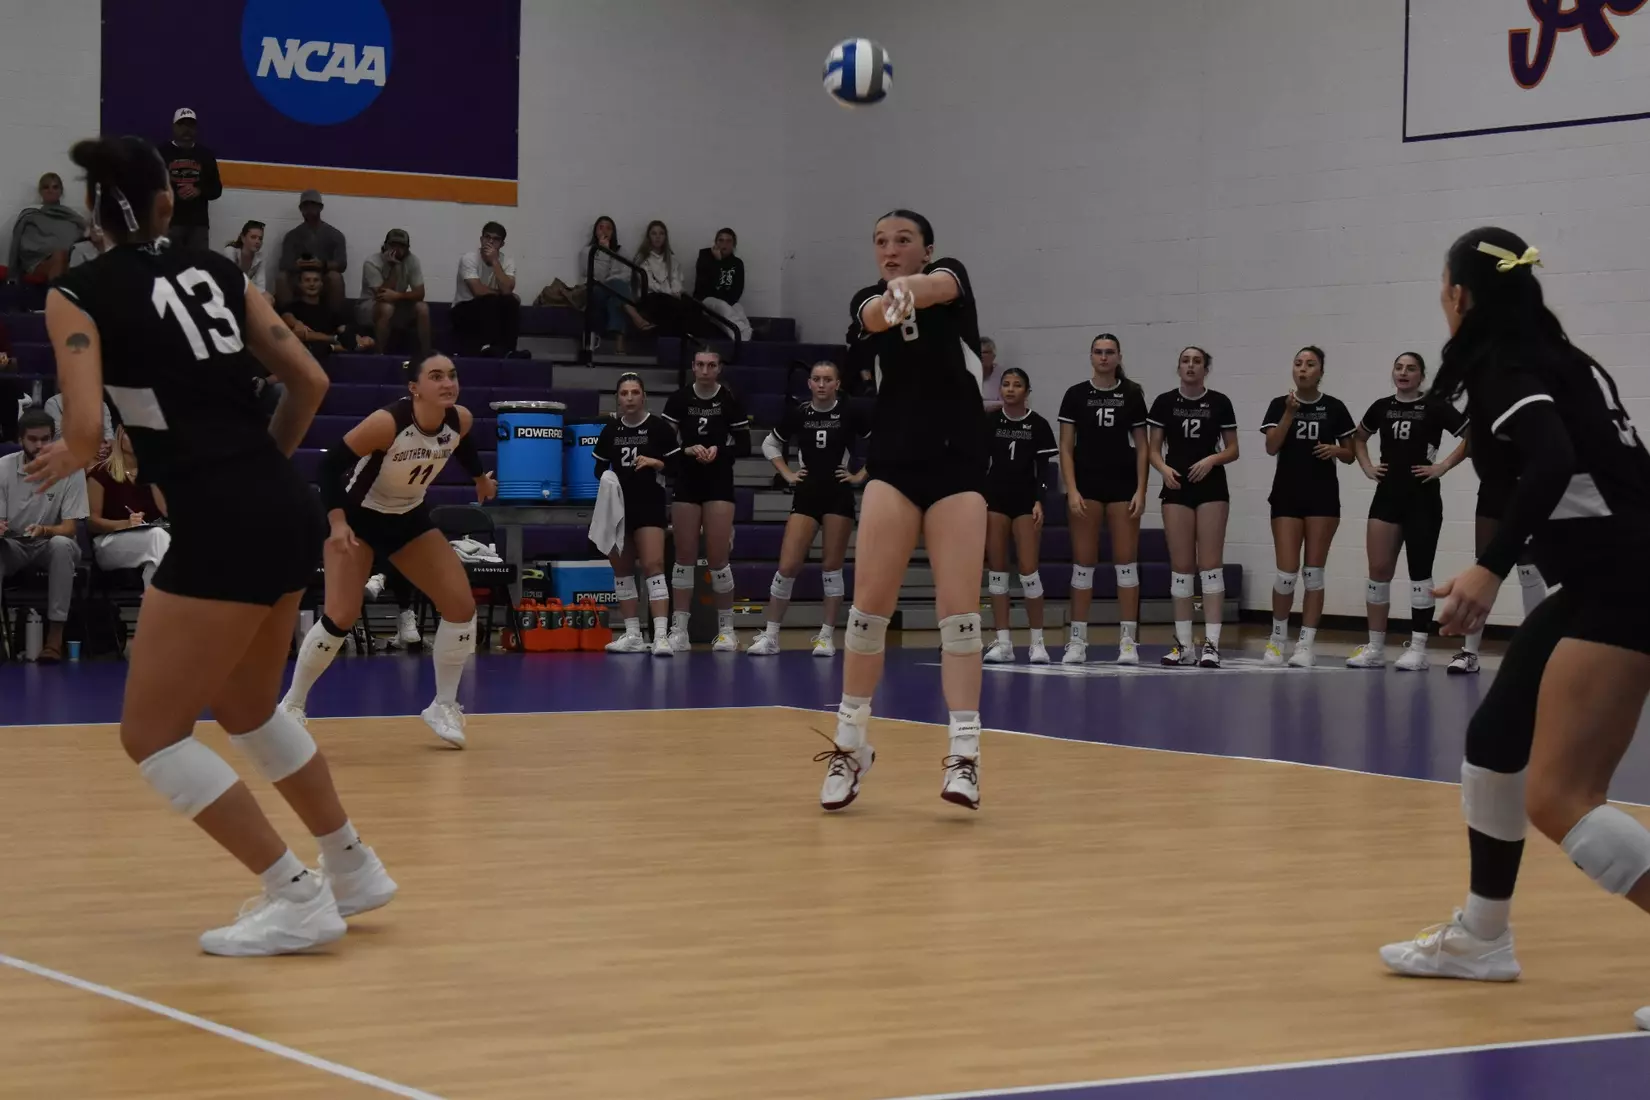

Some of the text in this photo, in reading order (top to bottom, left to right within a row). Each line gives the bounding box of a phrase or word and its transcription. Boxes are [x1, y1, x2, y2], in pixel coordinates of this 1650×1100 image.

[256, 36, 387, 87] NCAA
[151, 266, 245, 361] 13
[900, 307, 919, 342] 8
[697, 417, 708, 435] 2
[1096, 407, 1115, 427] 15
[1181, 418, 1201, 438] 12
[1296, 420, 1319, 440] 20
[1391, 420, 1412, 440] 18
[815, 430, 827, 449] 9
[392, 447, 432, 462] SOUTHERN
[620, 446, 638, 467] 21
[1008, 440, 1016, 460] 1
[408, 464, 434, 485] 11
[522, 616, 530, 627] G
